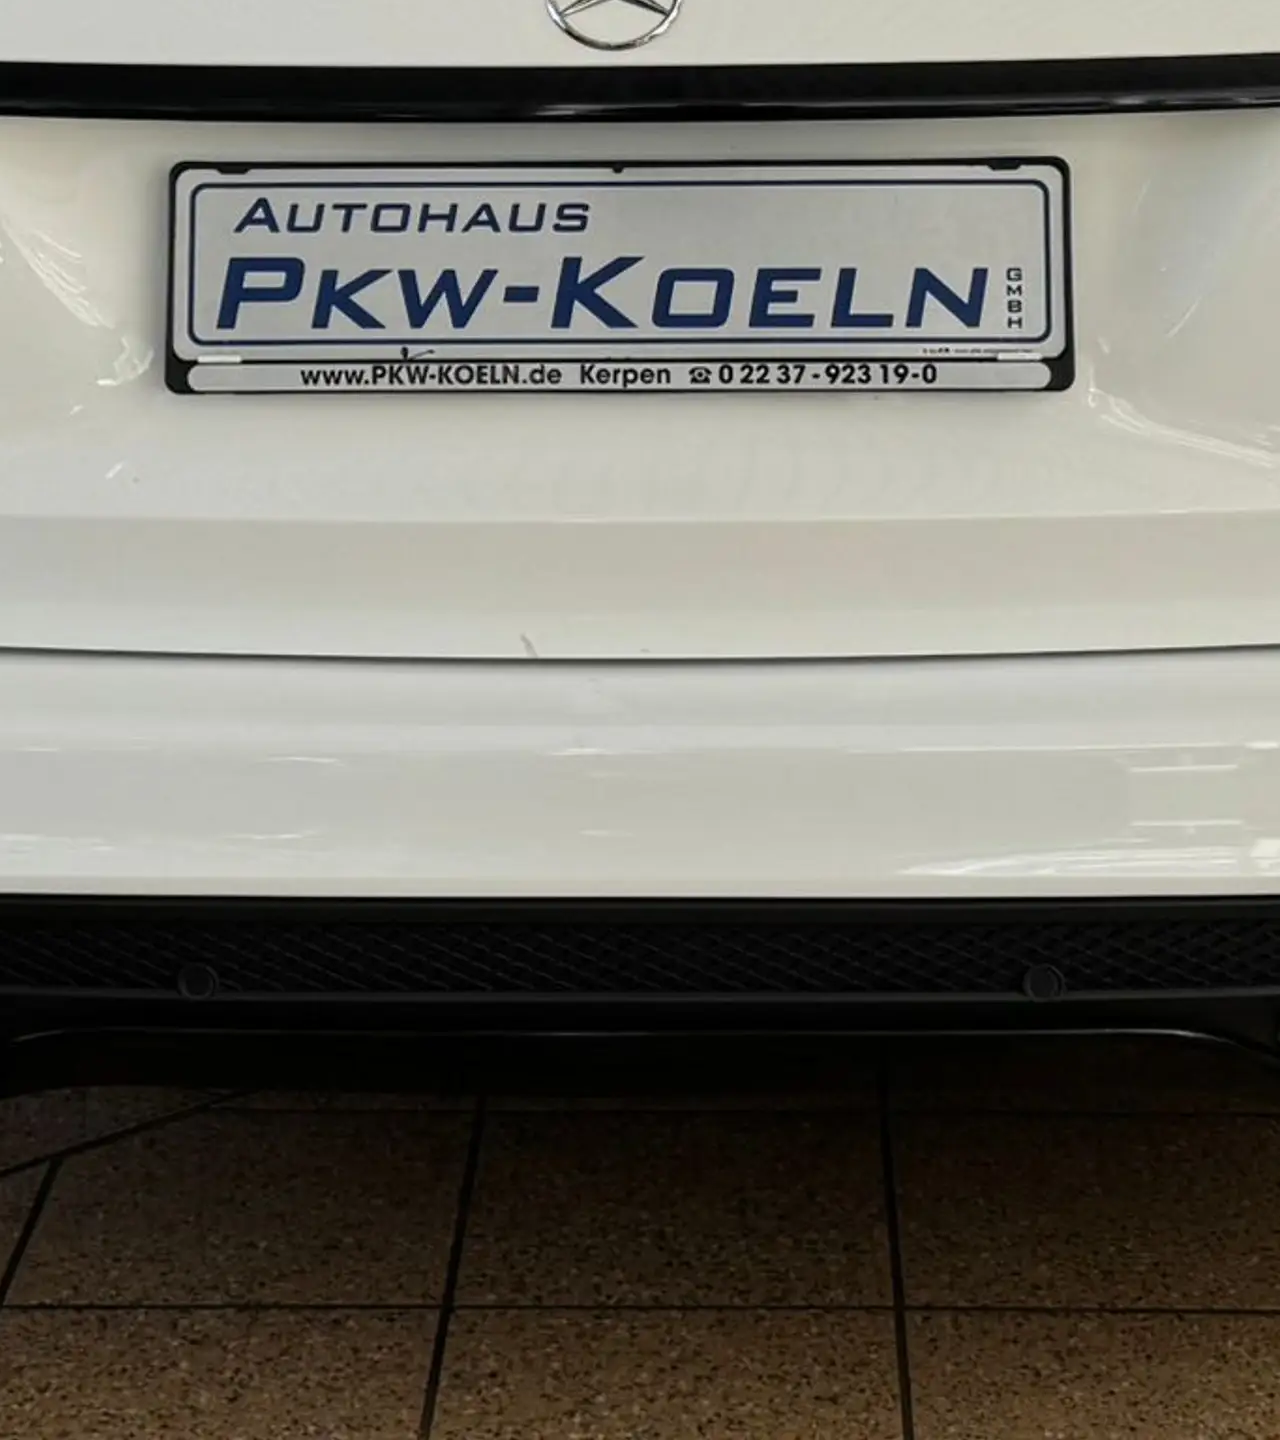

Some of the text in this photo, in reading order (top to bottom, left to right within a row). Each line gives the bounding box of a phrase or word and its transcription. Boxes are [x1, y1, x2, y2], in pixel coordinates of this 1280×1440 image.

[233, 196, 591, 234] AUTOHAUS
[215, 256, 989, 330] PKW-KOELN
[300, 363, 563, 387] www.PKW-KOELN.de
[579, 364, 671, 389] Kerpen
